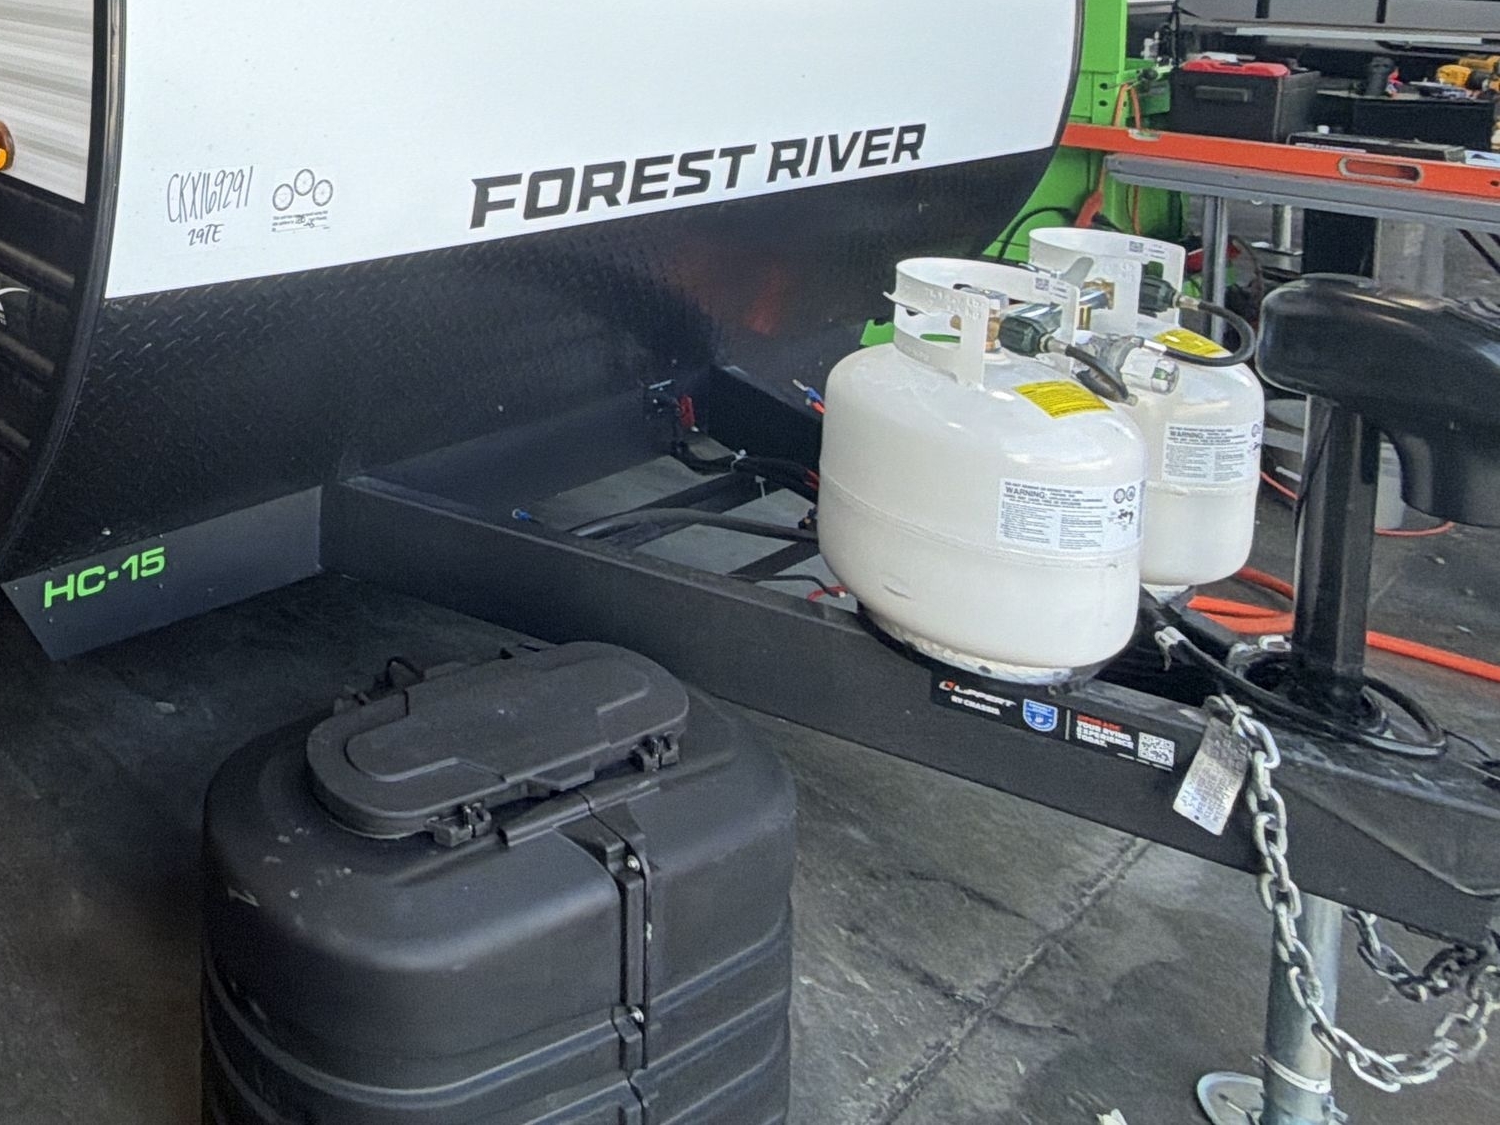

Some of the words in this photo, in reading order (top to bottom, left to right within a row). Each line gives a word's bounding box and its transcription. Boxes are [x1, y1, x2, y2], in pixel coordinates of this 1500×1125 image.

[470, 143, 757, 229] FOREST
[766, 122, 927, 184] RIVER
[1005, 486, 1048, 500] WARNING:
[43, 546, 166, 609] HC-15
